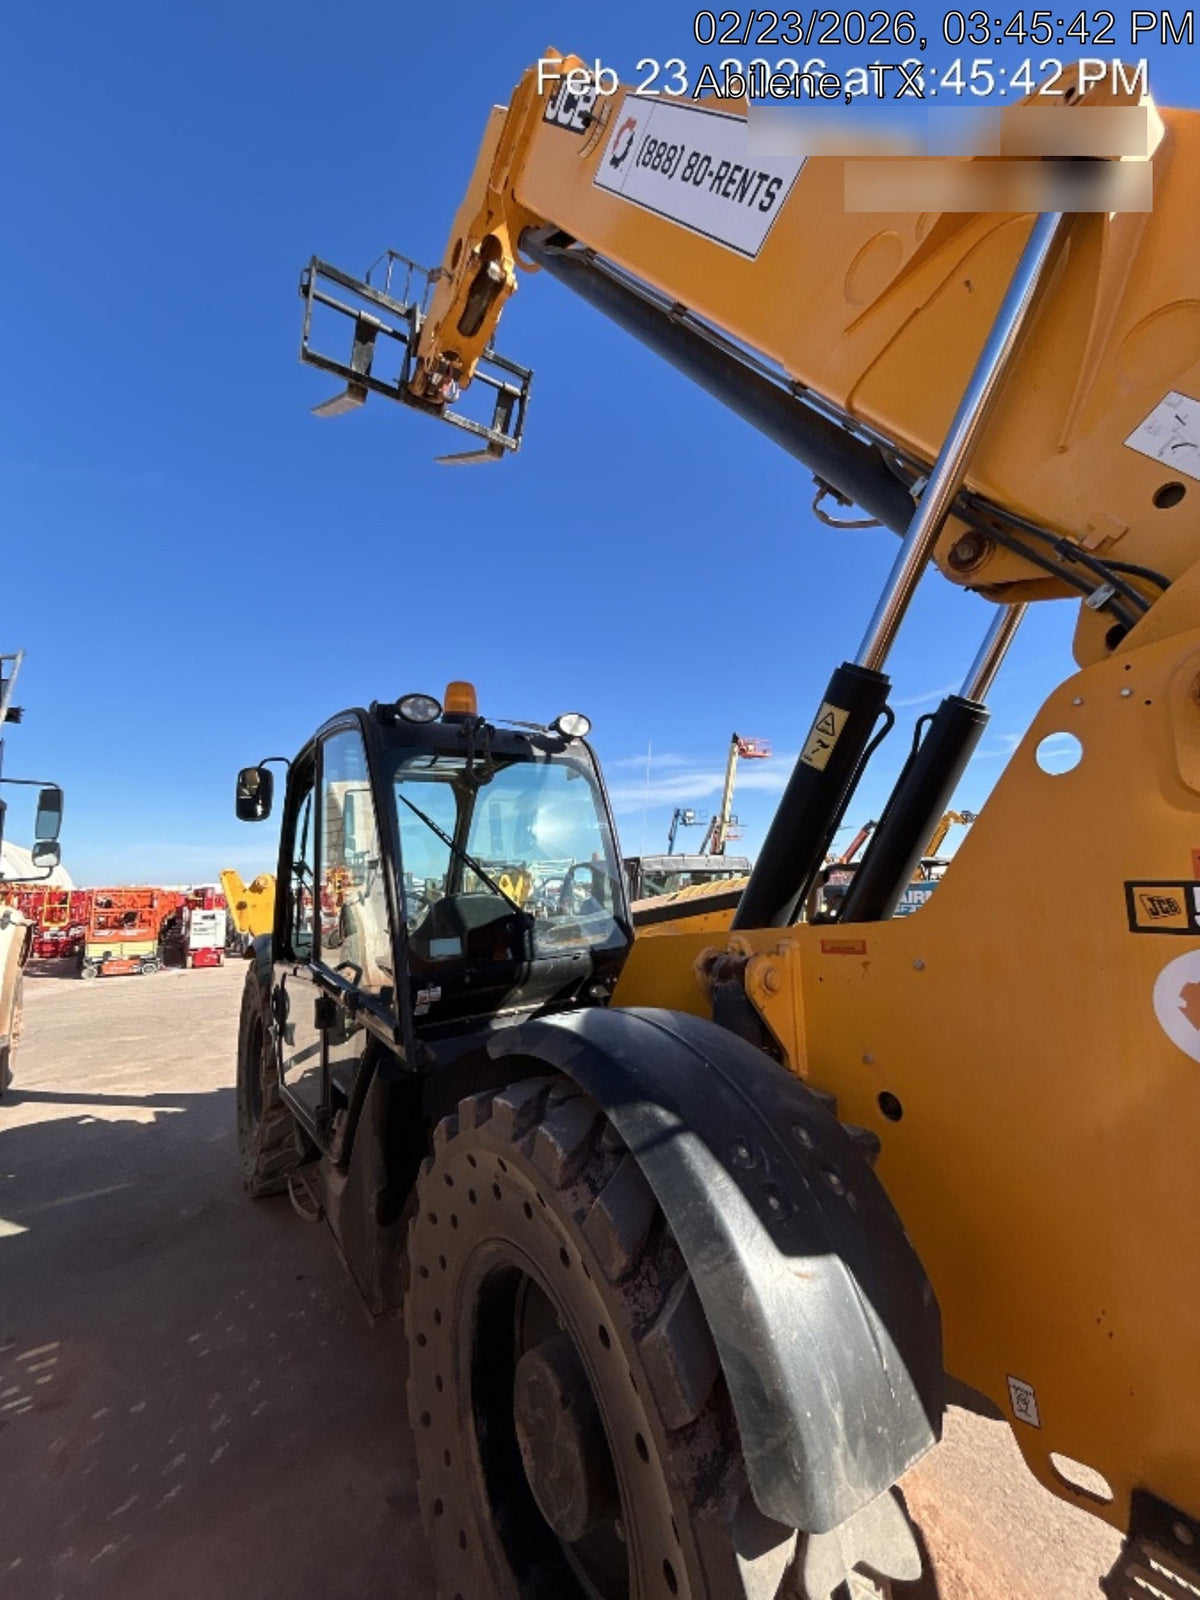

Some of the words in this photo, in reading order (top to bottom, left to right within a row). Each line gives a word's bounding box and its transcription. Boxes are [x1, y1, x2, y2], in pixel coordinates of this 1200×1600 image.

[636, 134, 686, 180] (888)
[681, 150, 783, 213] 80-RENTS
[1143, 895, 1180, 918] JCB
